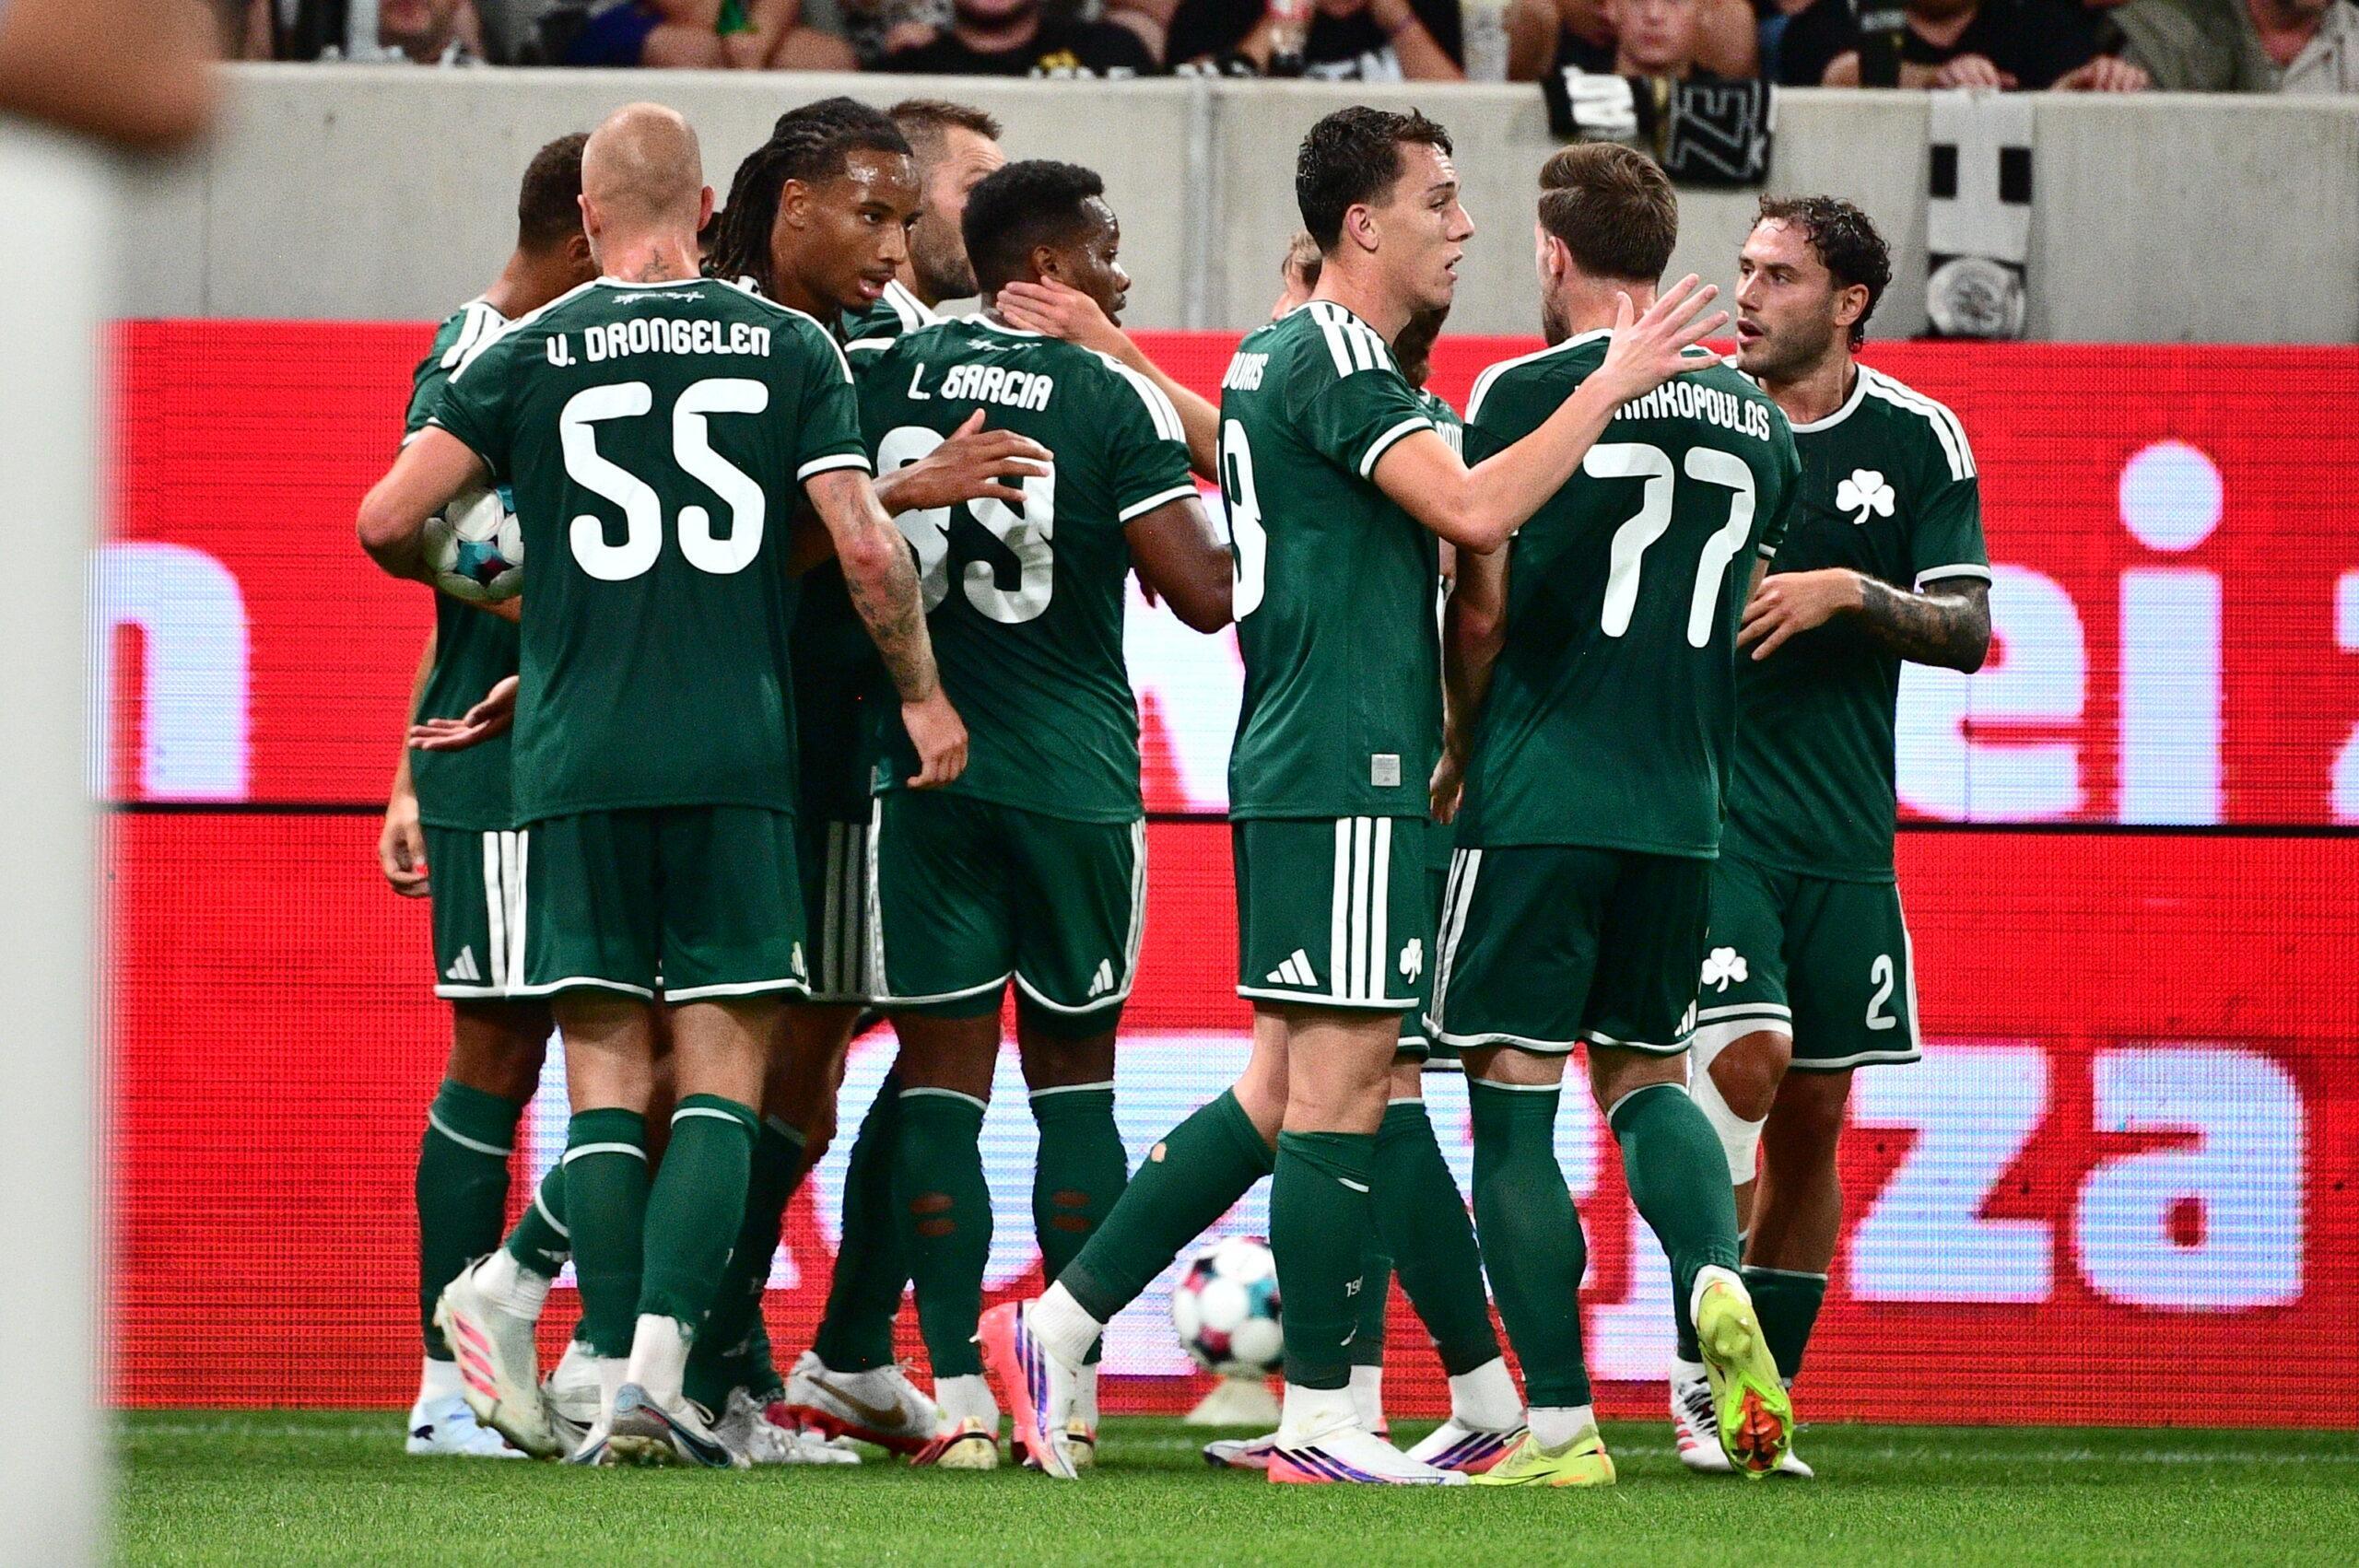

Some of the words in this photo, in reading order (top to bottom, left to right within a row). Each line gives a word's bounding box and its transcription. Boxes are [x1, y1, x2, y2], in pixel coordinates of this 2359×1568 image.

[583, 317, 771, 363] DRONGELEN
[940, 363, 1054, 413] GARCIA
[558, 377, 770, 582] 55
[1582, 441, 1757, 649] 77
[1865, 953, 1897, 1030] 2
